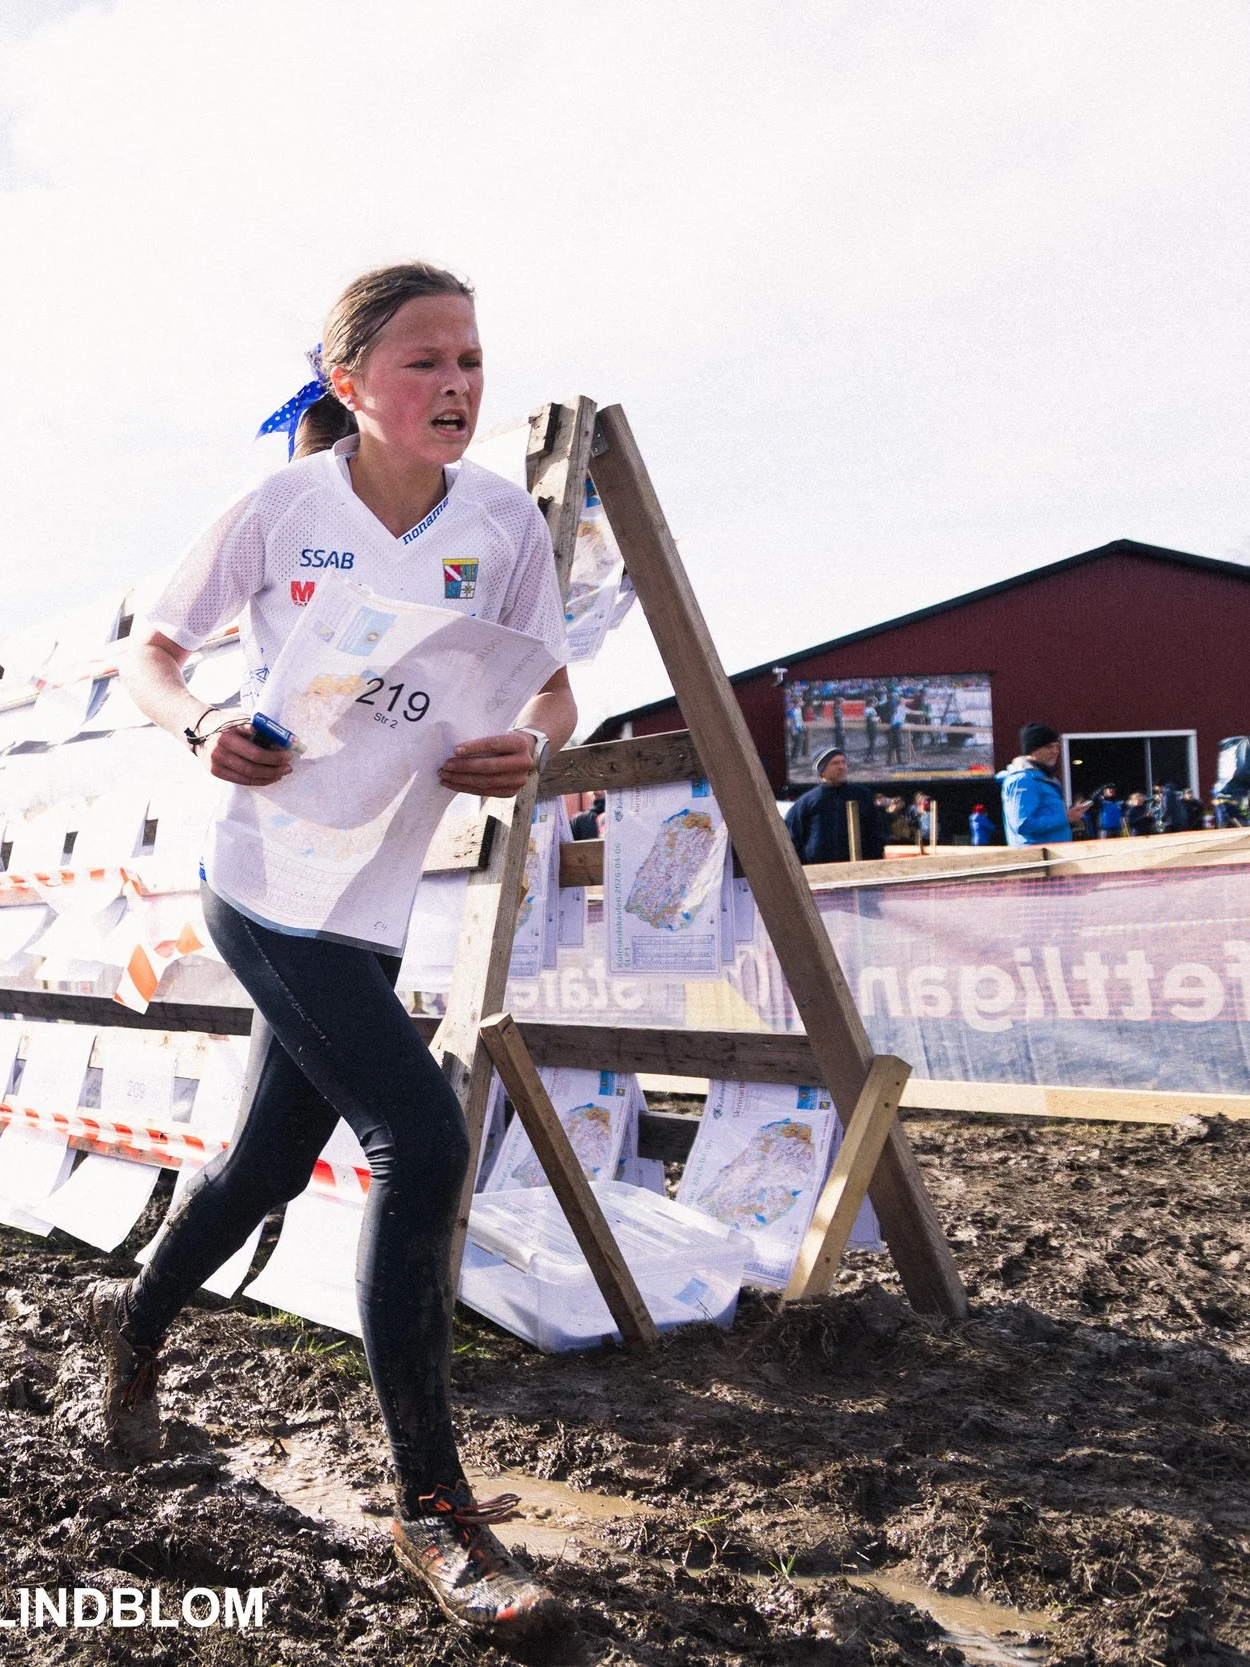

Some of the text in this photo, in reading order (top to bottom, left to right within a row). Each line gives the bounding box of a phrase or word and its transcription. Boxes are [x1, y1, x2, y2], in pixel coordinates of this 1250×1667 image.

[402, 497, 449, 545] noname
[299, 548, 355, 569] SSAB
[354, 677, 431, 722] 219
[373, 712, 399, 729] Str 2
